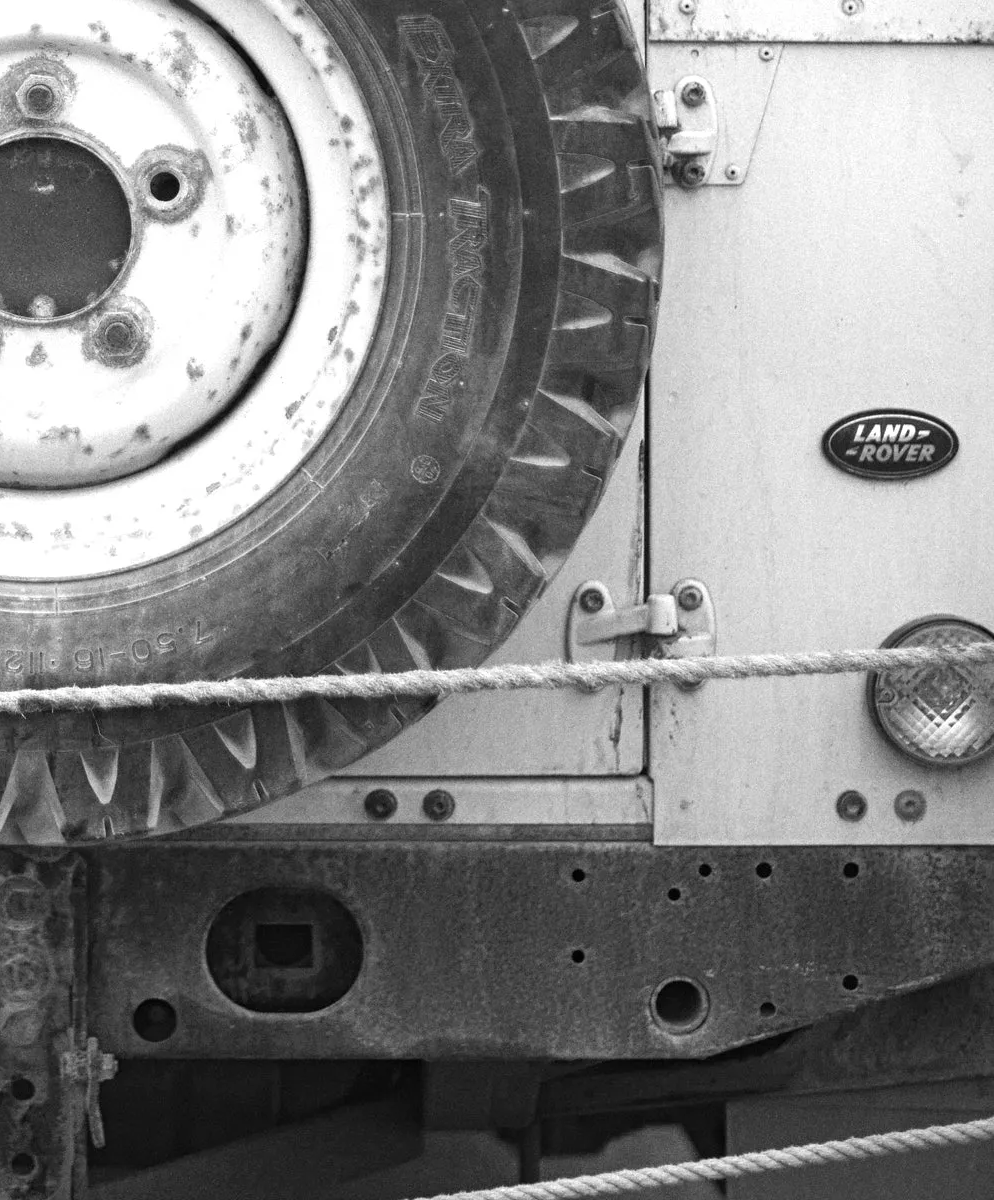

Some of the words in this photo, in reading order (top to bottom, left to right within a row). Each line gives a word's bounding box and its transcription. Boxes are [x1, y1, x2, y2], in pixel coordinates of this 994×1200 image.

[397, 15, 482, 177] EXTRA
[413, 183, 491, 424] TRACTION
[73, 618, 215, 674] 7.50-16
